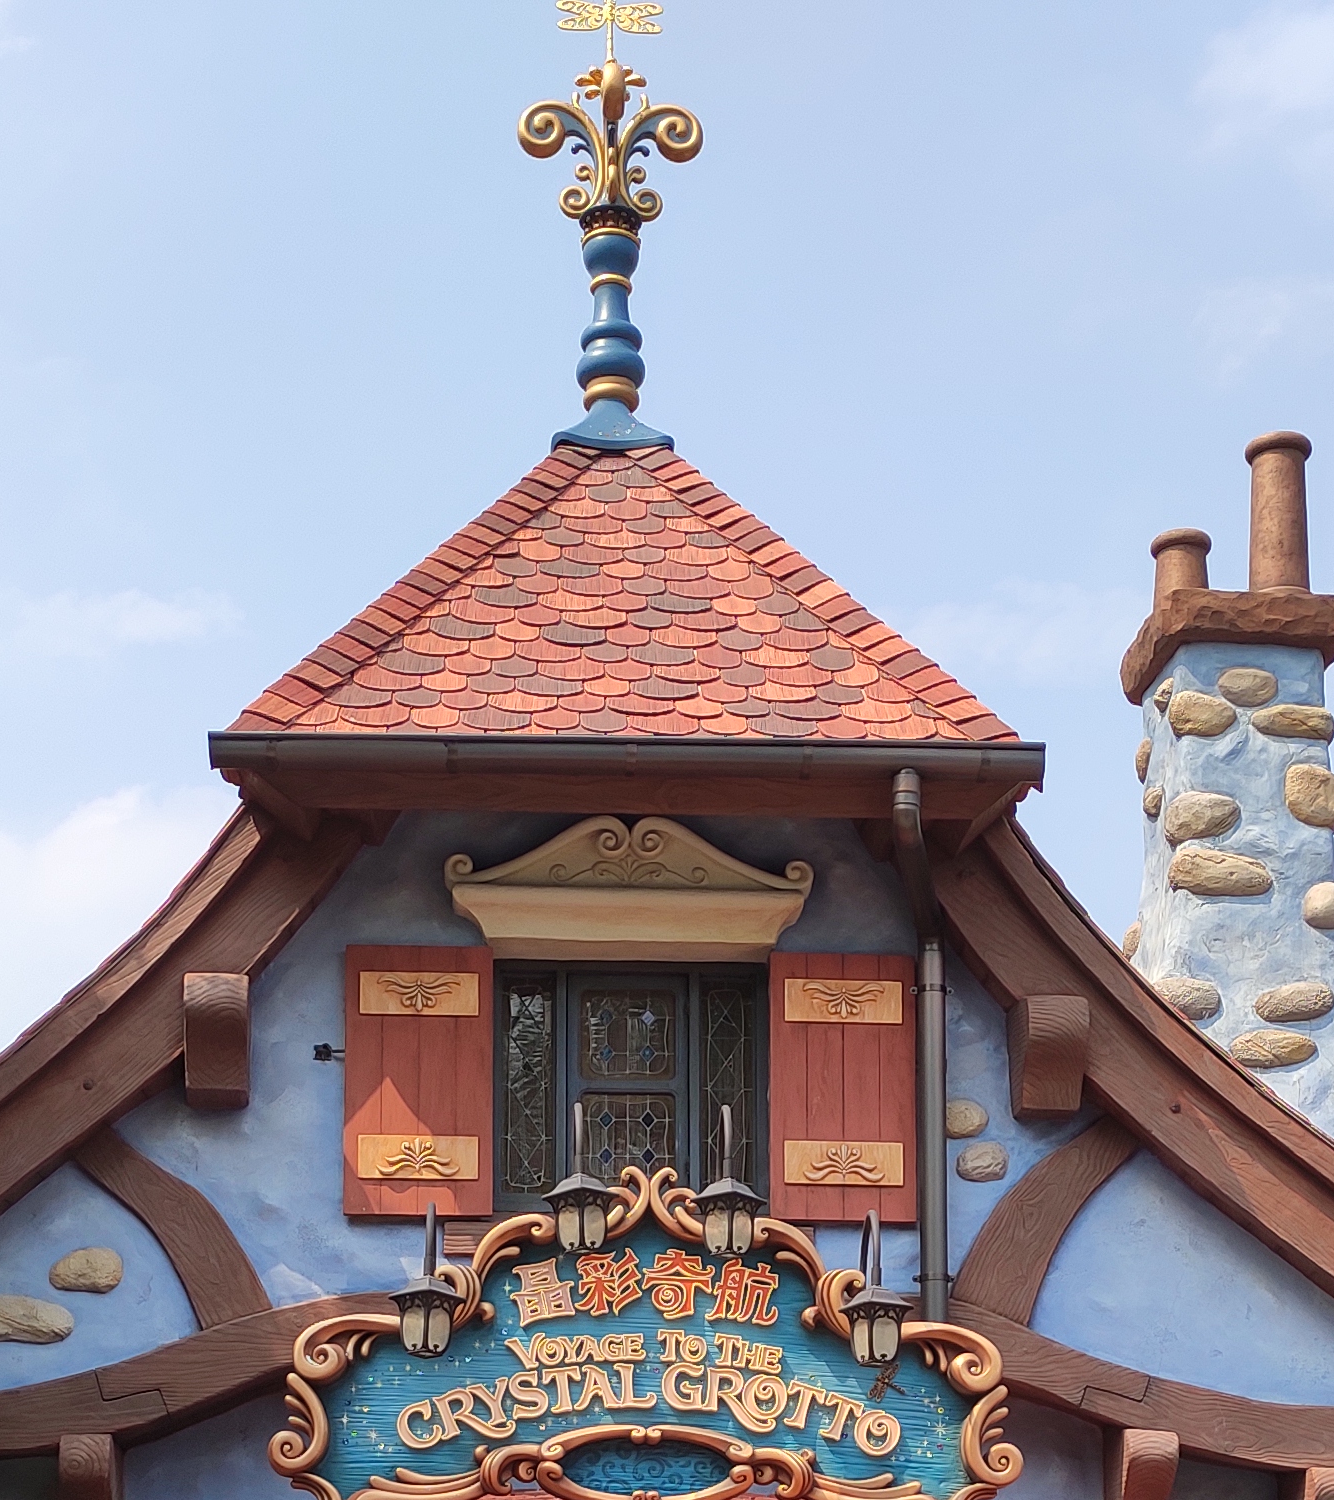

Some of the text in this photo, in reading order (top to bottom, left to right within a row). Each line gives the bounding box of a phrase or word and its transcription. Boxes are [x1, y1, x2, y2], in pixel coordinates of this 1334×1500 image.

[510, 1247, 780, 1328] 晶彩奇航
[506, 1329, 783, 1375] VOYAGE TO THE
[396, 1363, 902, 1457] CRYSTAL GROTTO
